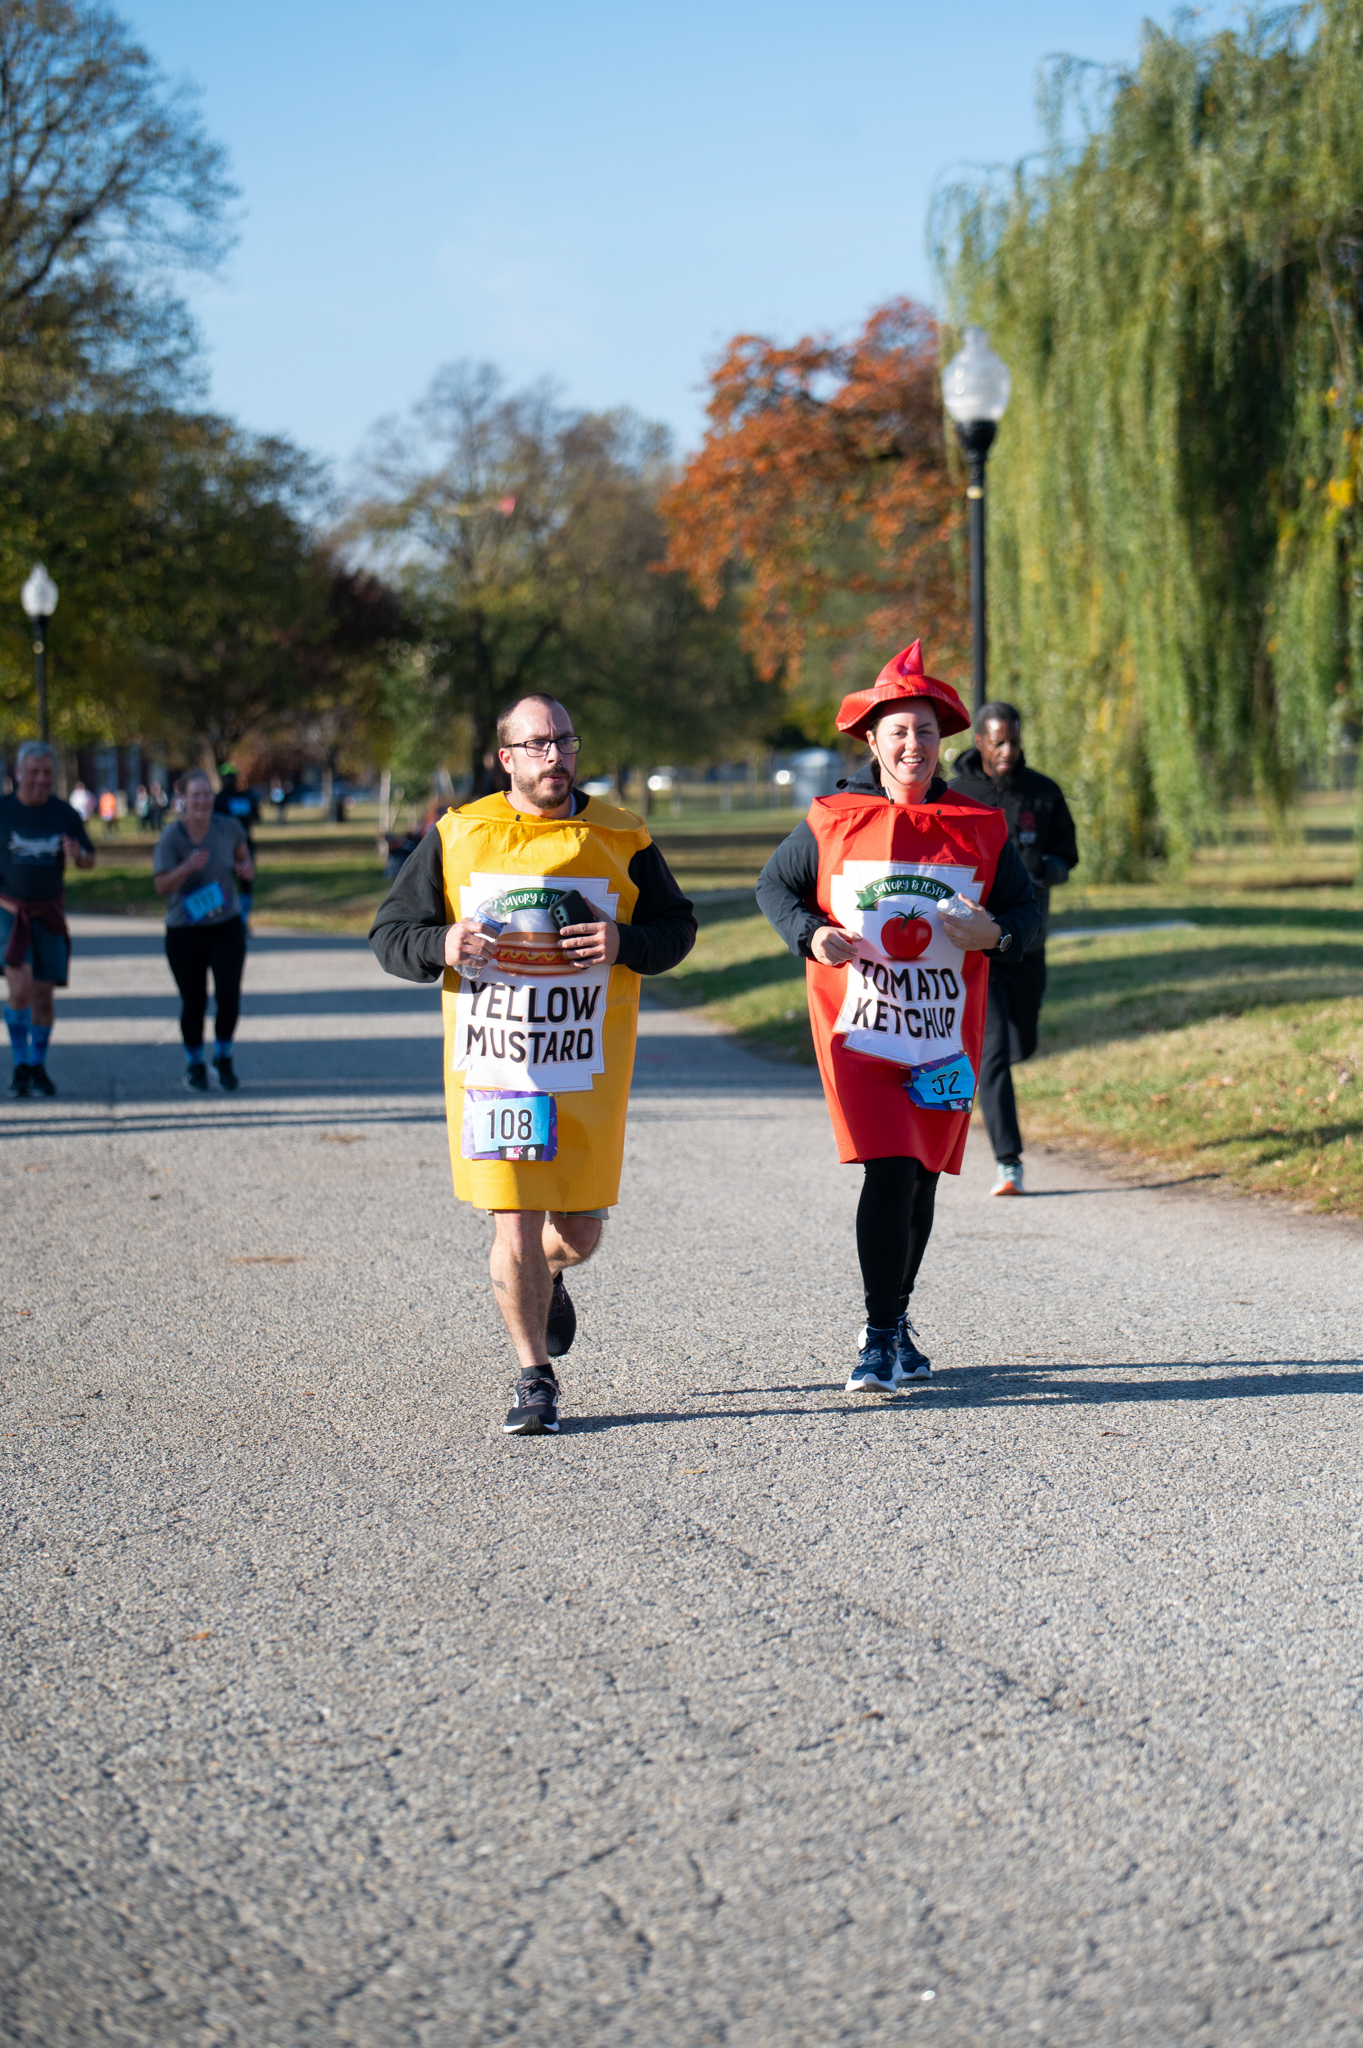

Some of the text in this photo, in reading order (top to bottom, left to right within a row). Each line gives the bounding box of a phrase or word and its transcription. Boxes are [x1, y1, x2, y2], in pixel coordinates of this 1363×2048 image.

[540, 892, 549, 904] &
[911, 879, 920, 891] &
[859, 958, 960, 1002] TOMATO
[469, 980, 602, 1023] YELLOW
[851, 996, 956, 1039] KETCHUP
[465, 1023, 594, 1065] MUSTARD
[486, 1107, 533, 1141] 108
